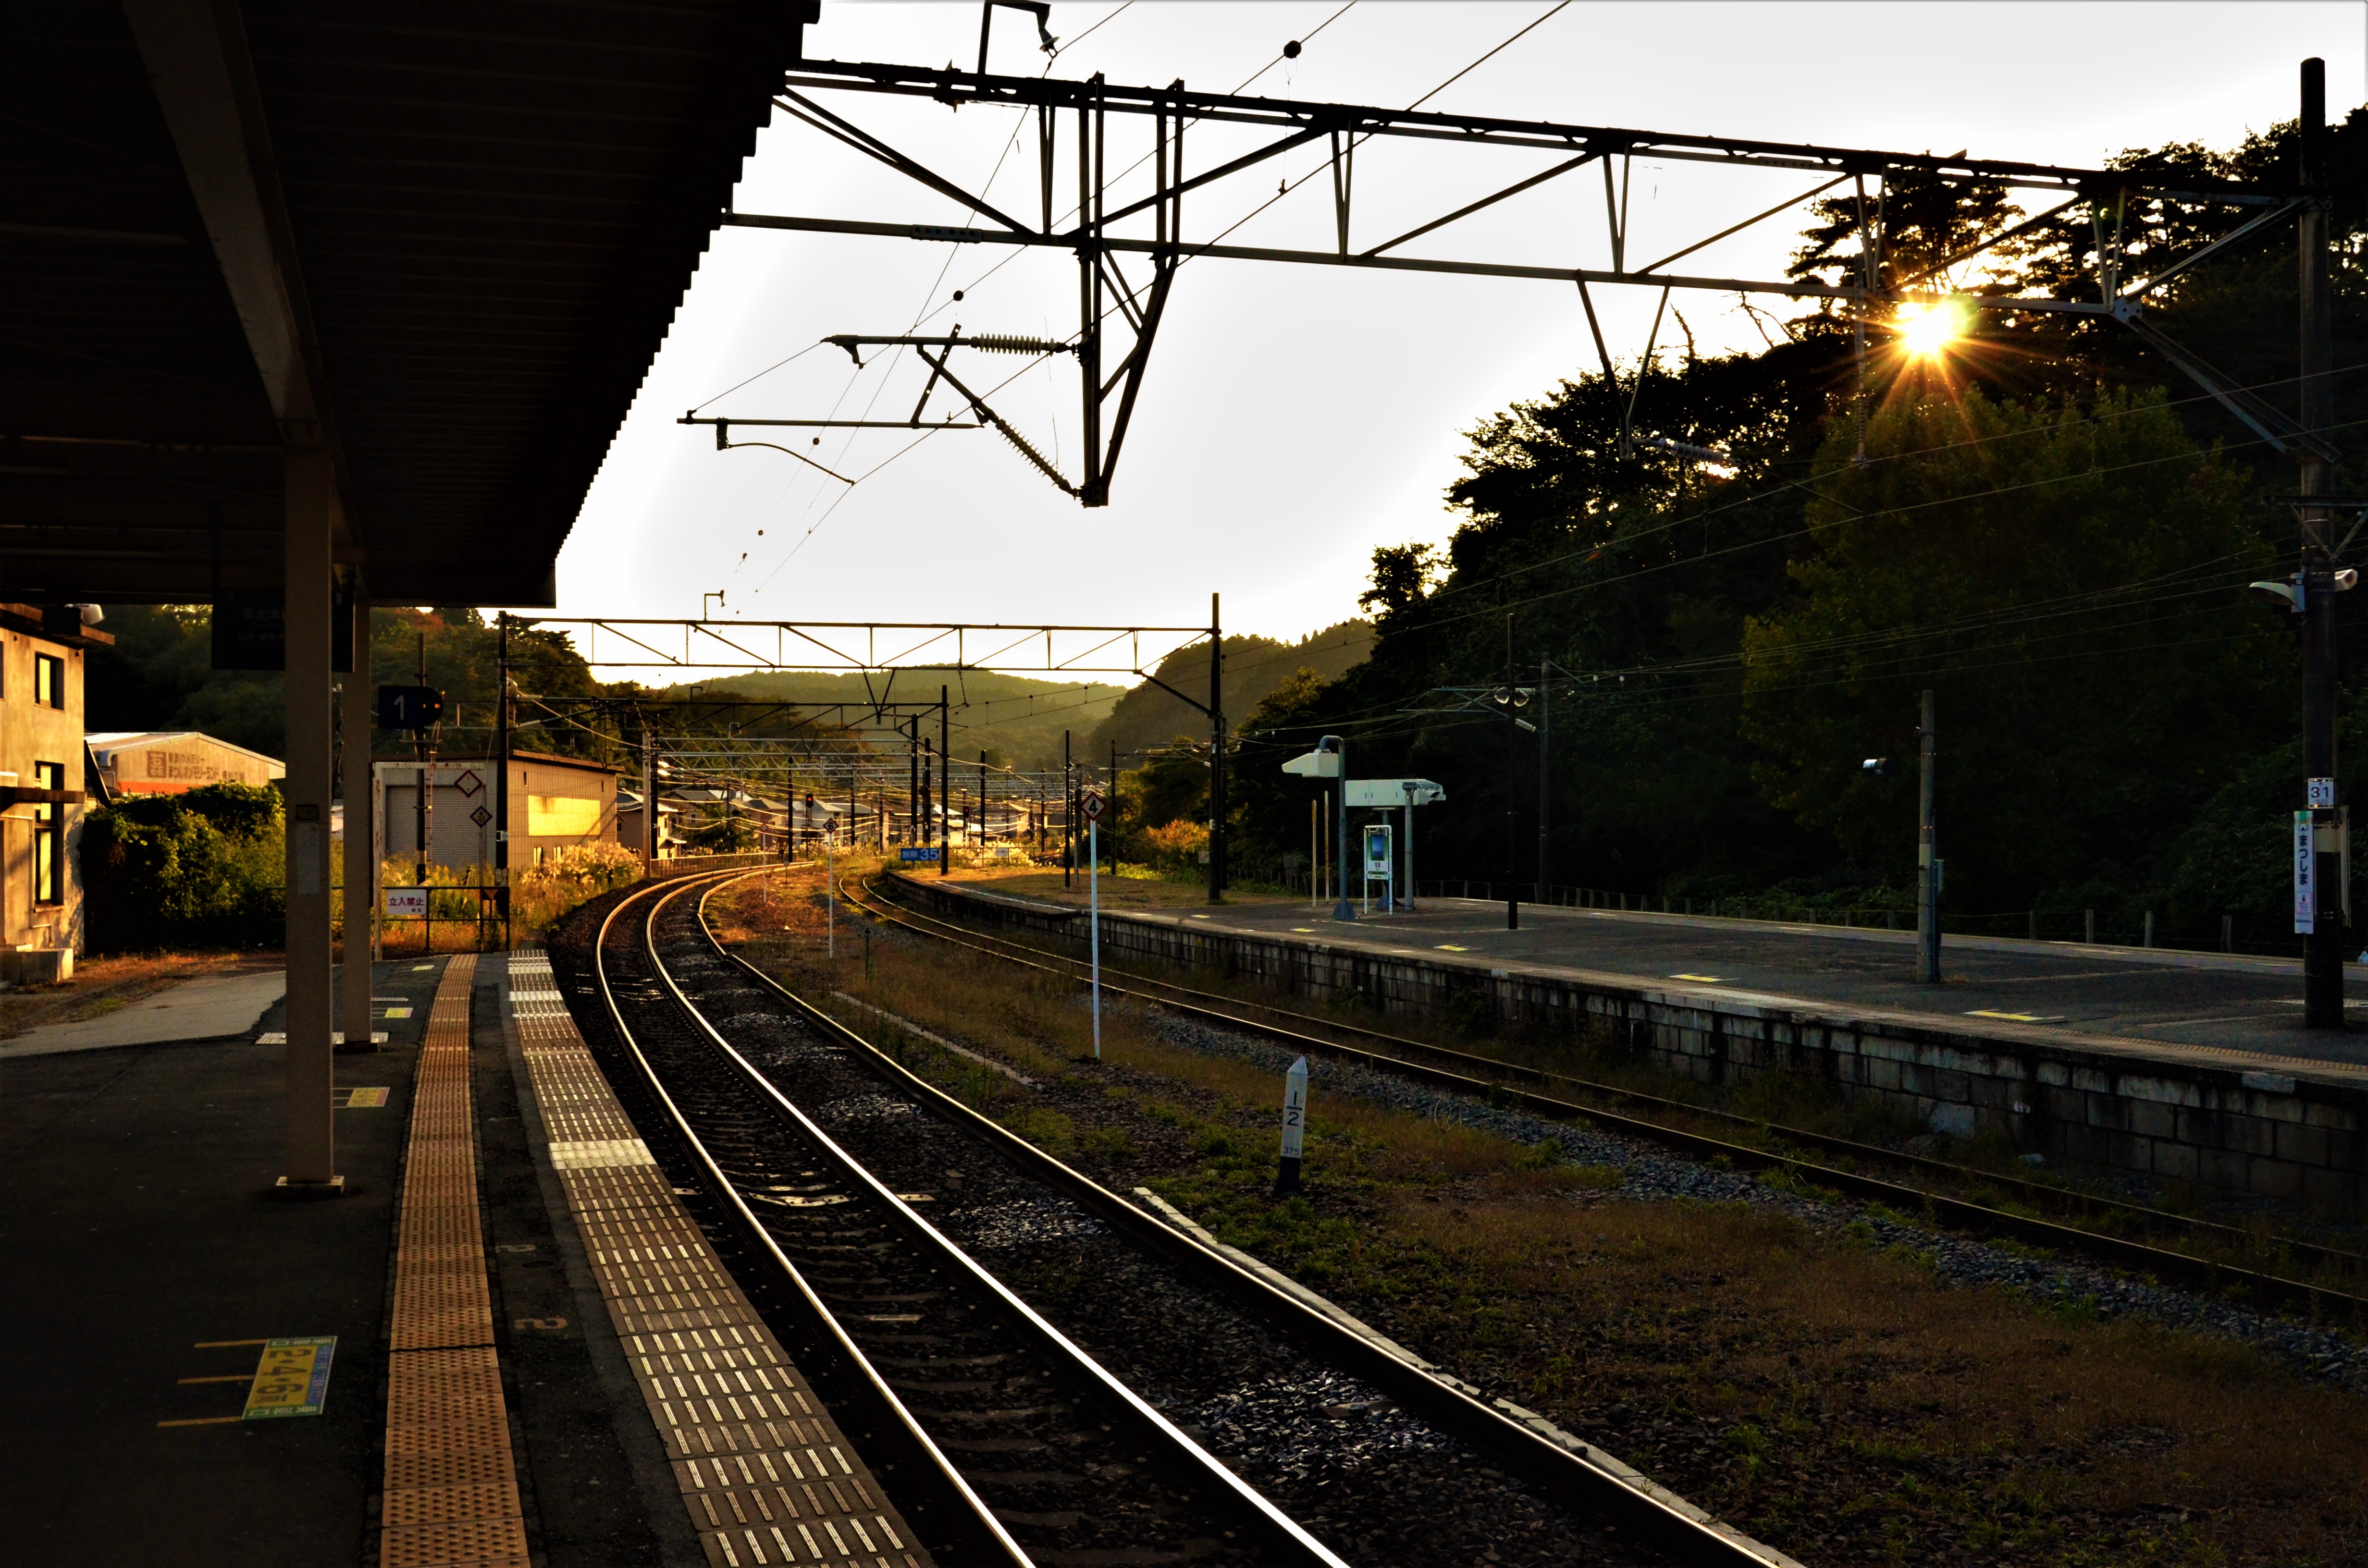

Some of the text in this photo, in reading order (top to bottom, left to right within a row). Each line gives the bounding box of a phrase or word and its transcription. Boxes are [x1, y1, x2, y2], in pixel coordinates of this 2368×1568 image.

[393, 694, 405, 721] 1
[2311, 786, 2329, 798] 31
[1089, 799, 1098, 813] 4
[920, 848, 939, 860] 35
[2299, 835, 2308, 885] まつしま
[388, 897, 424, 906] 立入禁止
[1287, 1112, 1299, 1126] 2
[1283, 1146, 1299, 1155] 375
